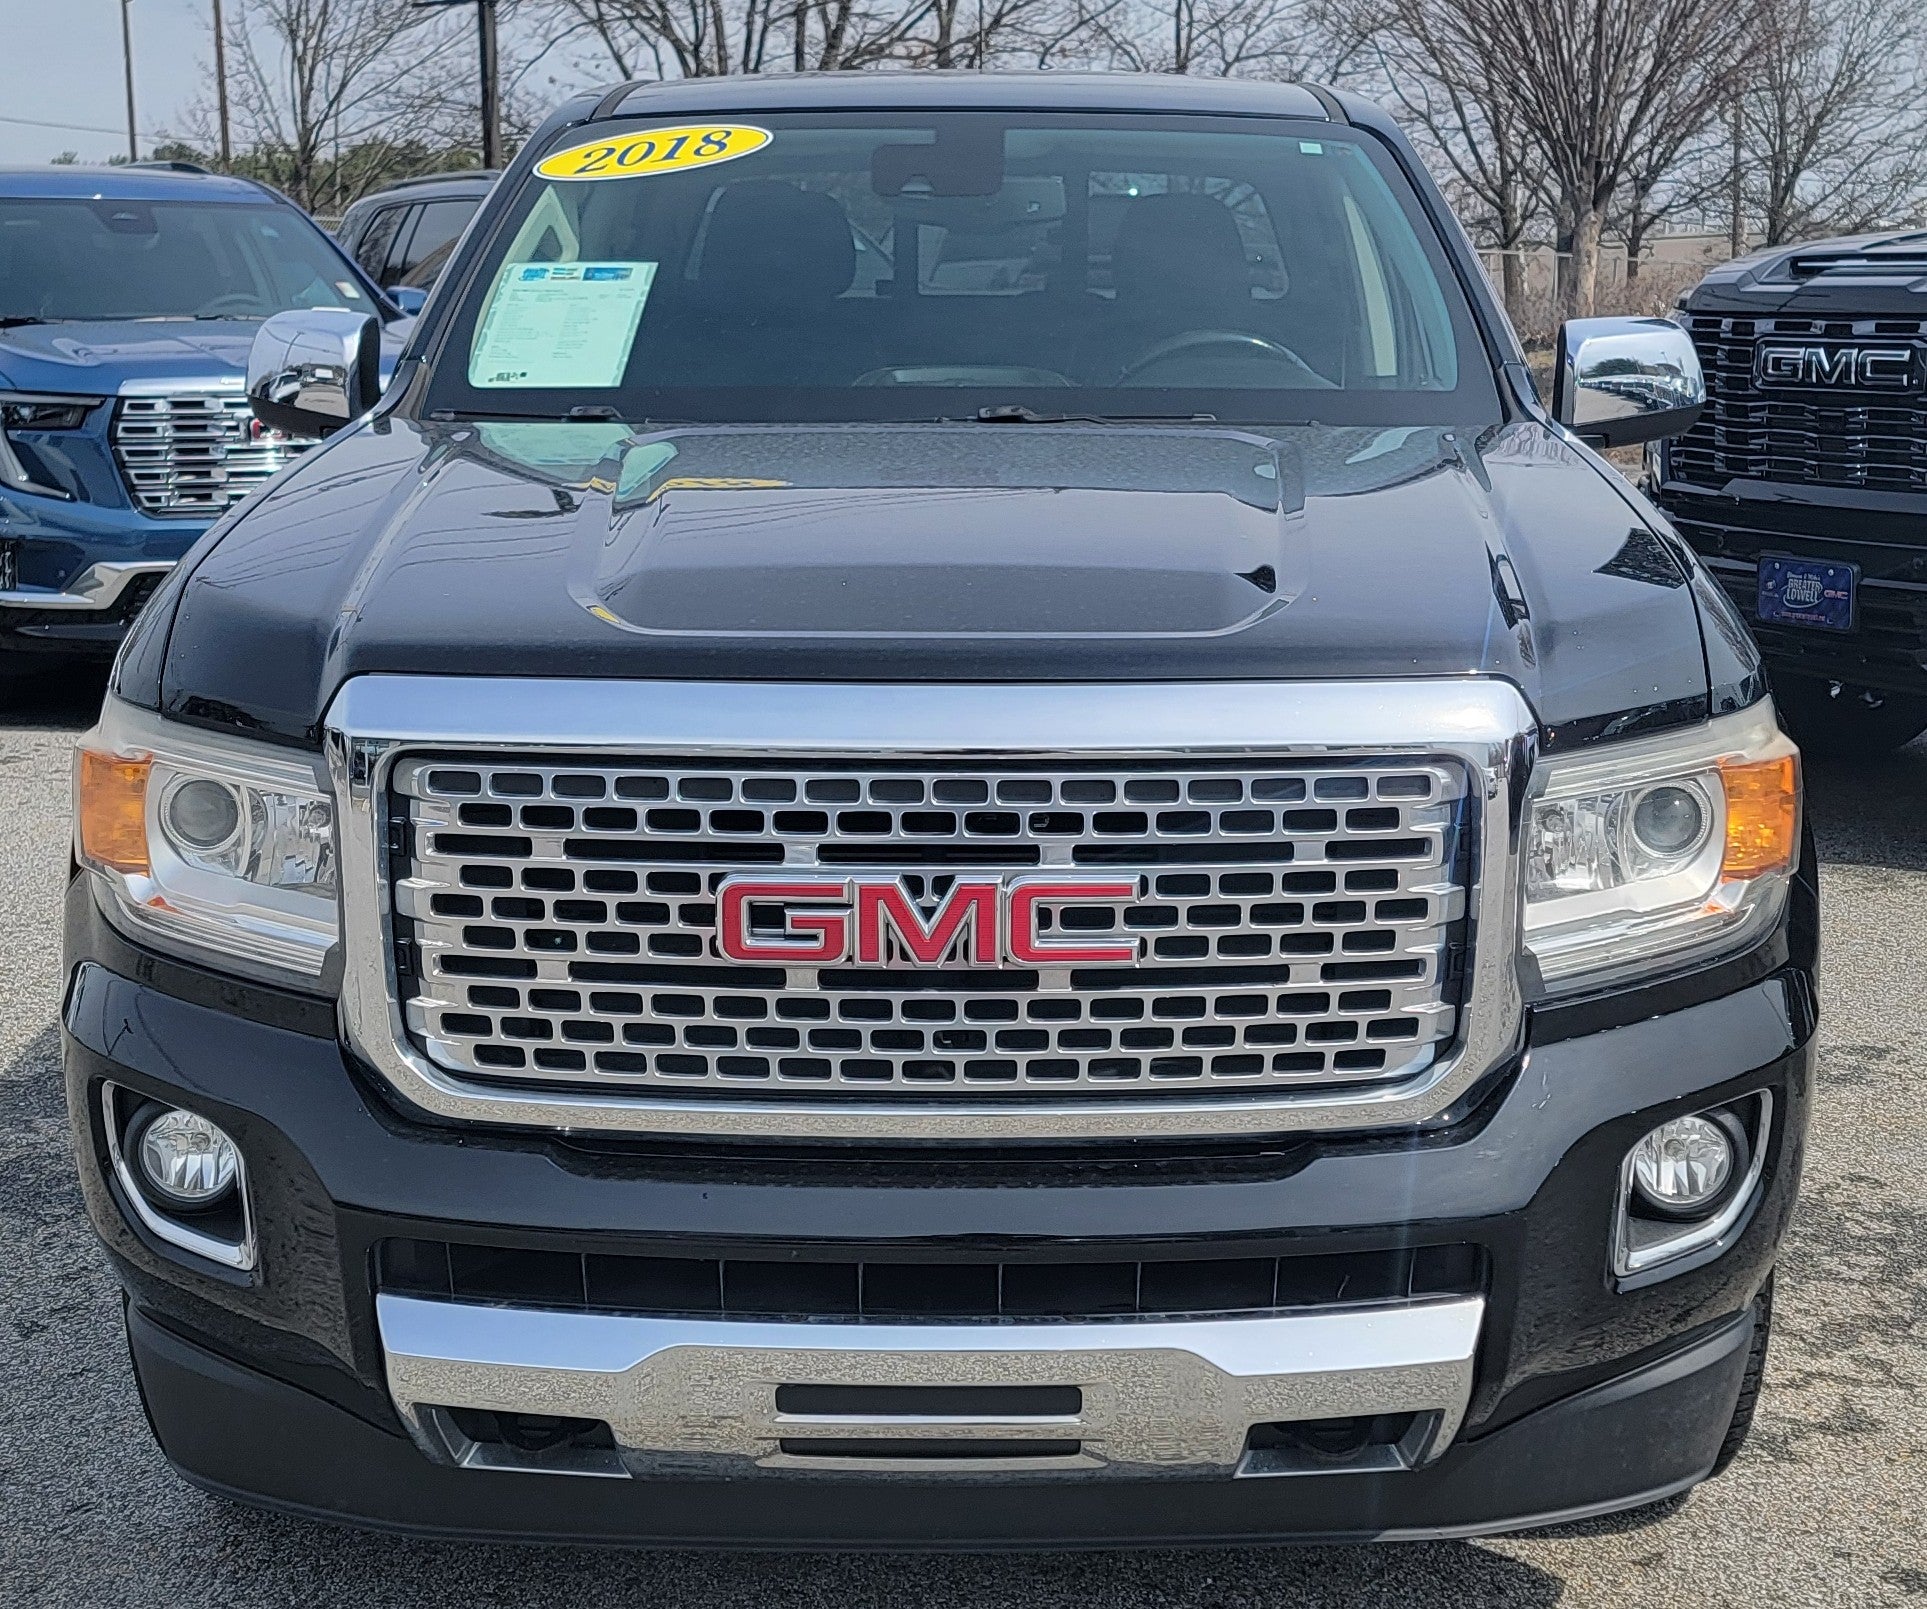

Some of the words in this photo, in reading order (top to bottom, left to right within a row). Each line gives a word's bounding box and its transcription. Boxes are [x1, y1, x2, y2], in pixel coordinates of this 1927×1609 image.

[573, 130, 732, 174] 2018
[1761, 346, 1911, 386] GMC
[1786, 588, 1819, 603] LOWELL
[1788, 579, 1820, 592] GREATER
[1823, 589, 1849, 600] GMC
[715, 873, 1141, 968] GMC
